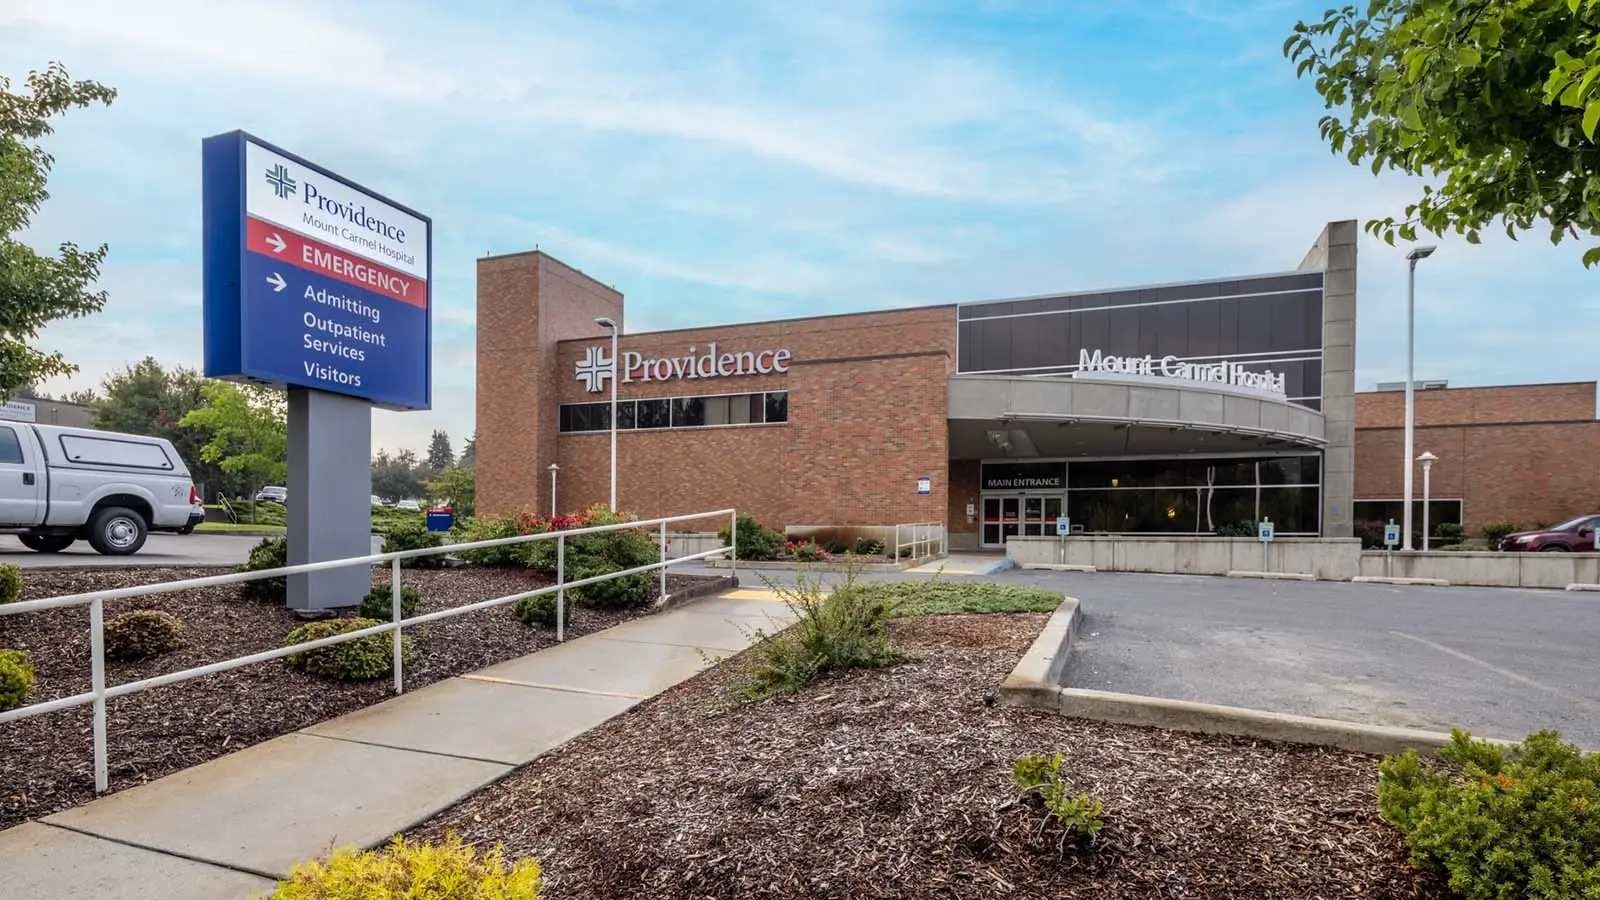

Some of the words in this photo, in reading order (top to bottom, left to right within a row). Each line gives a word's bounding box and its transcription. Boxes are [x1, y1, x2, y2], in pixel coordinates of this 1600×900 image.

[303, 182, 405, 243] Providence
[302, 212, 339, 237] Mount
[342, 227, 377, 250] Carmel
[379, 243, 415, 265] Hospital
[302, 244, 410, 296] EMERGENCY
[304, 285, 380, 323] Admitting
[303, 312, 386, 347] Outpatient
[303, 333, 365, 361] Services
[304, 361, 361, 387] Visitors
[622, 342, 791, 383] Providence
[1079, 348, 1154, 376] Mount
[1161, 355, 1227, 384] Carmel
[1230, 364, 1285, 393] Hospital
[988, 479, 1012, 487] MAIN
[1013, 478, 1060, 487] ENTRANCE
